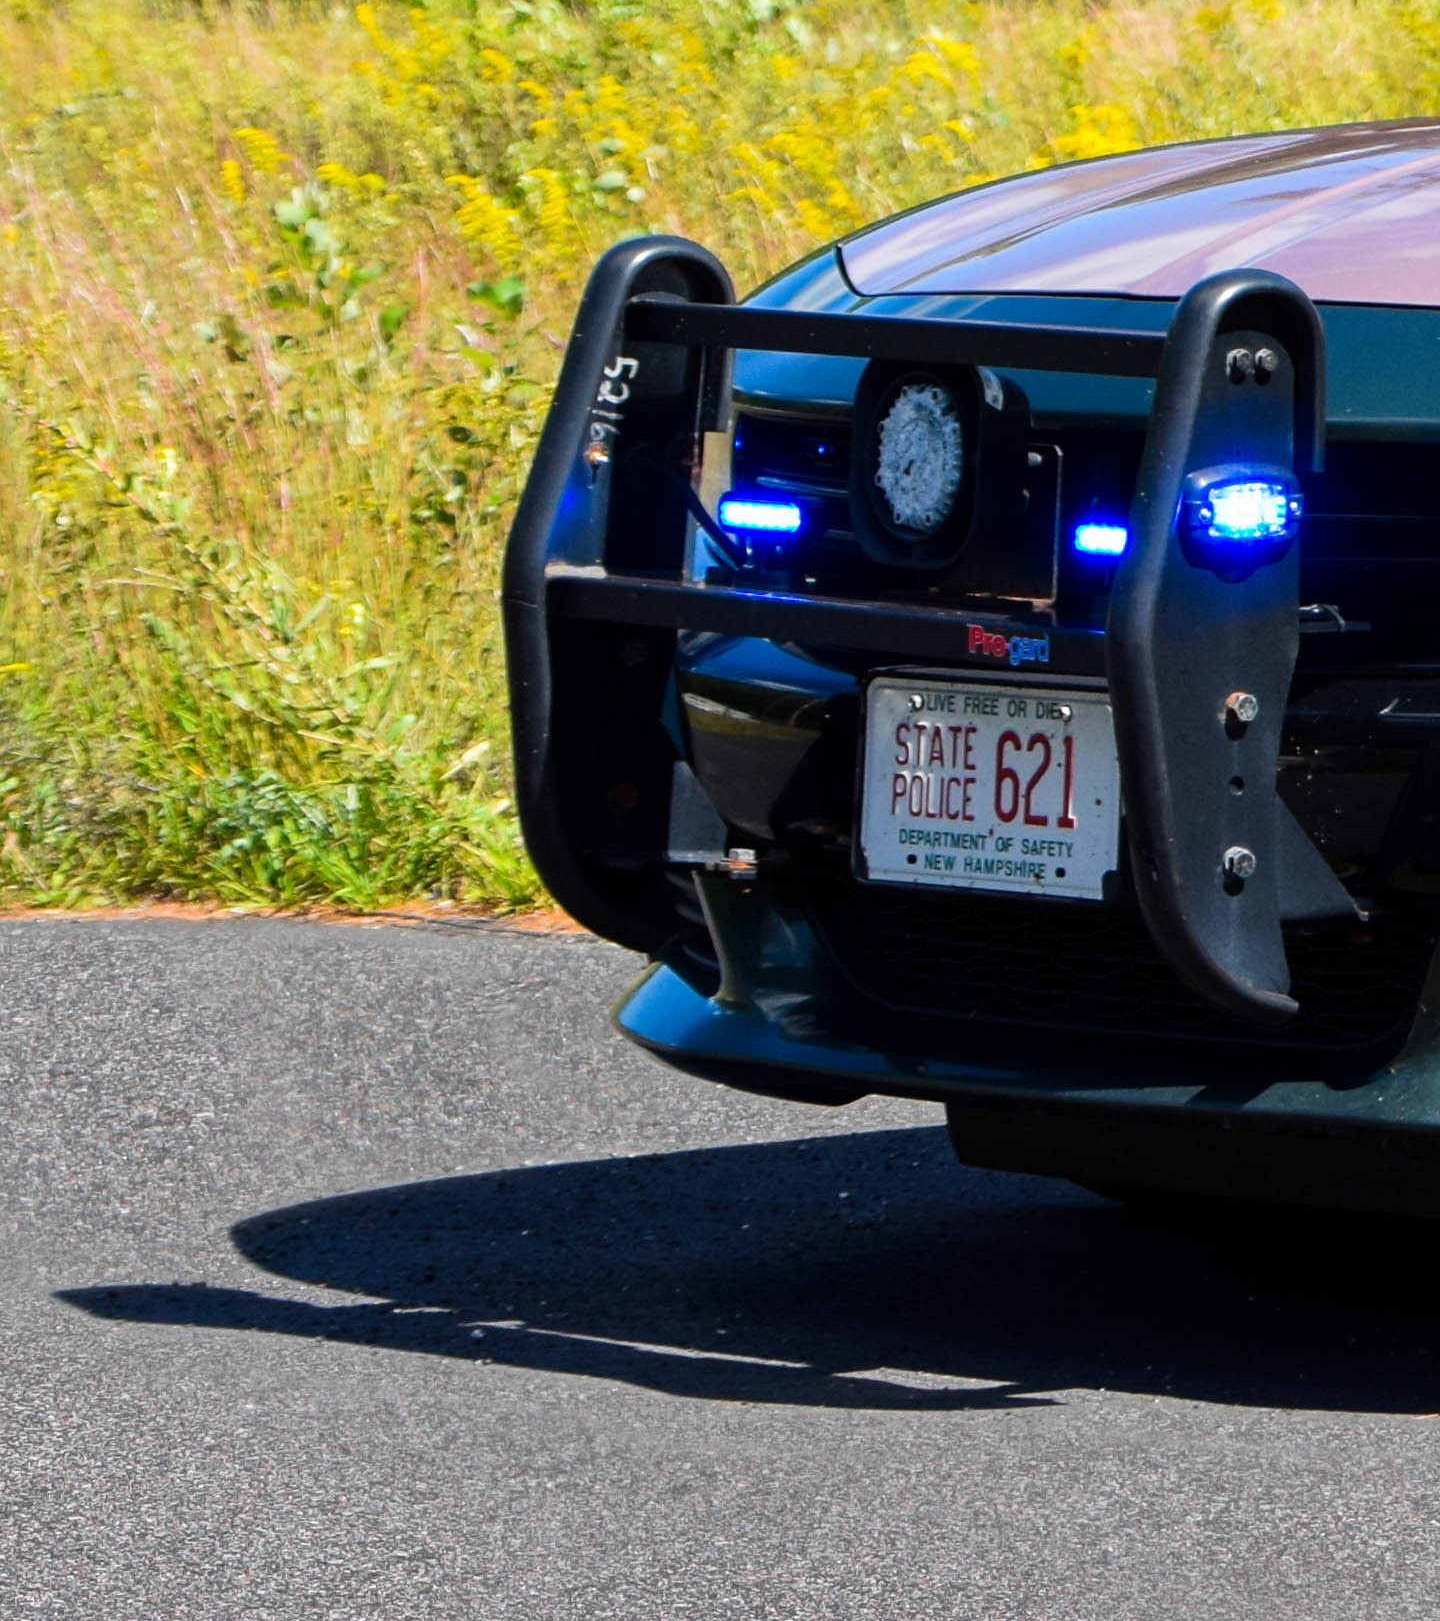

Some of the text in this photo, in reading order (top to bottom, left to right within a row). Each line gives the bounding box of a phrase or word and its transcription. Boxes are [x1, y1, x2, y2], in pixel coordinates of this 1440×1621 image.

[926, 694, 1062, 721] LIVE FREE OR DIE
[894, 722, 1077, 830] STATE 621
[891, 771, 977, 822] POLICE
[898, 827, 1074, 859] DEPARTMENT OF SAFETY
[923, 853, 1047, 880] NEW HAMPSHIRE
